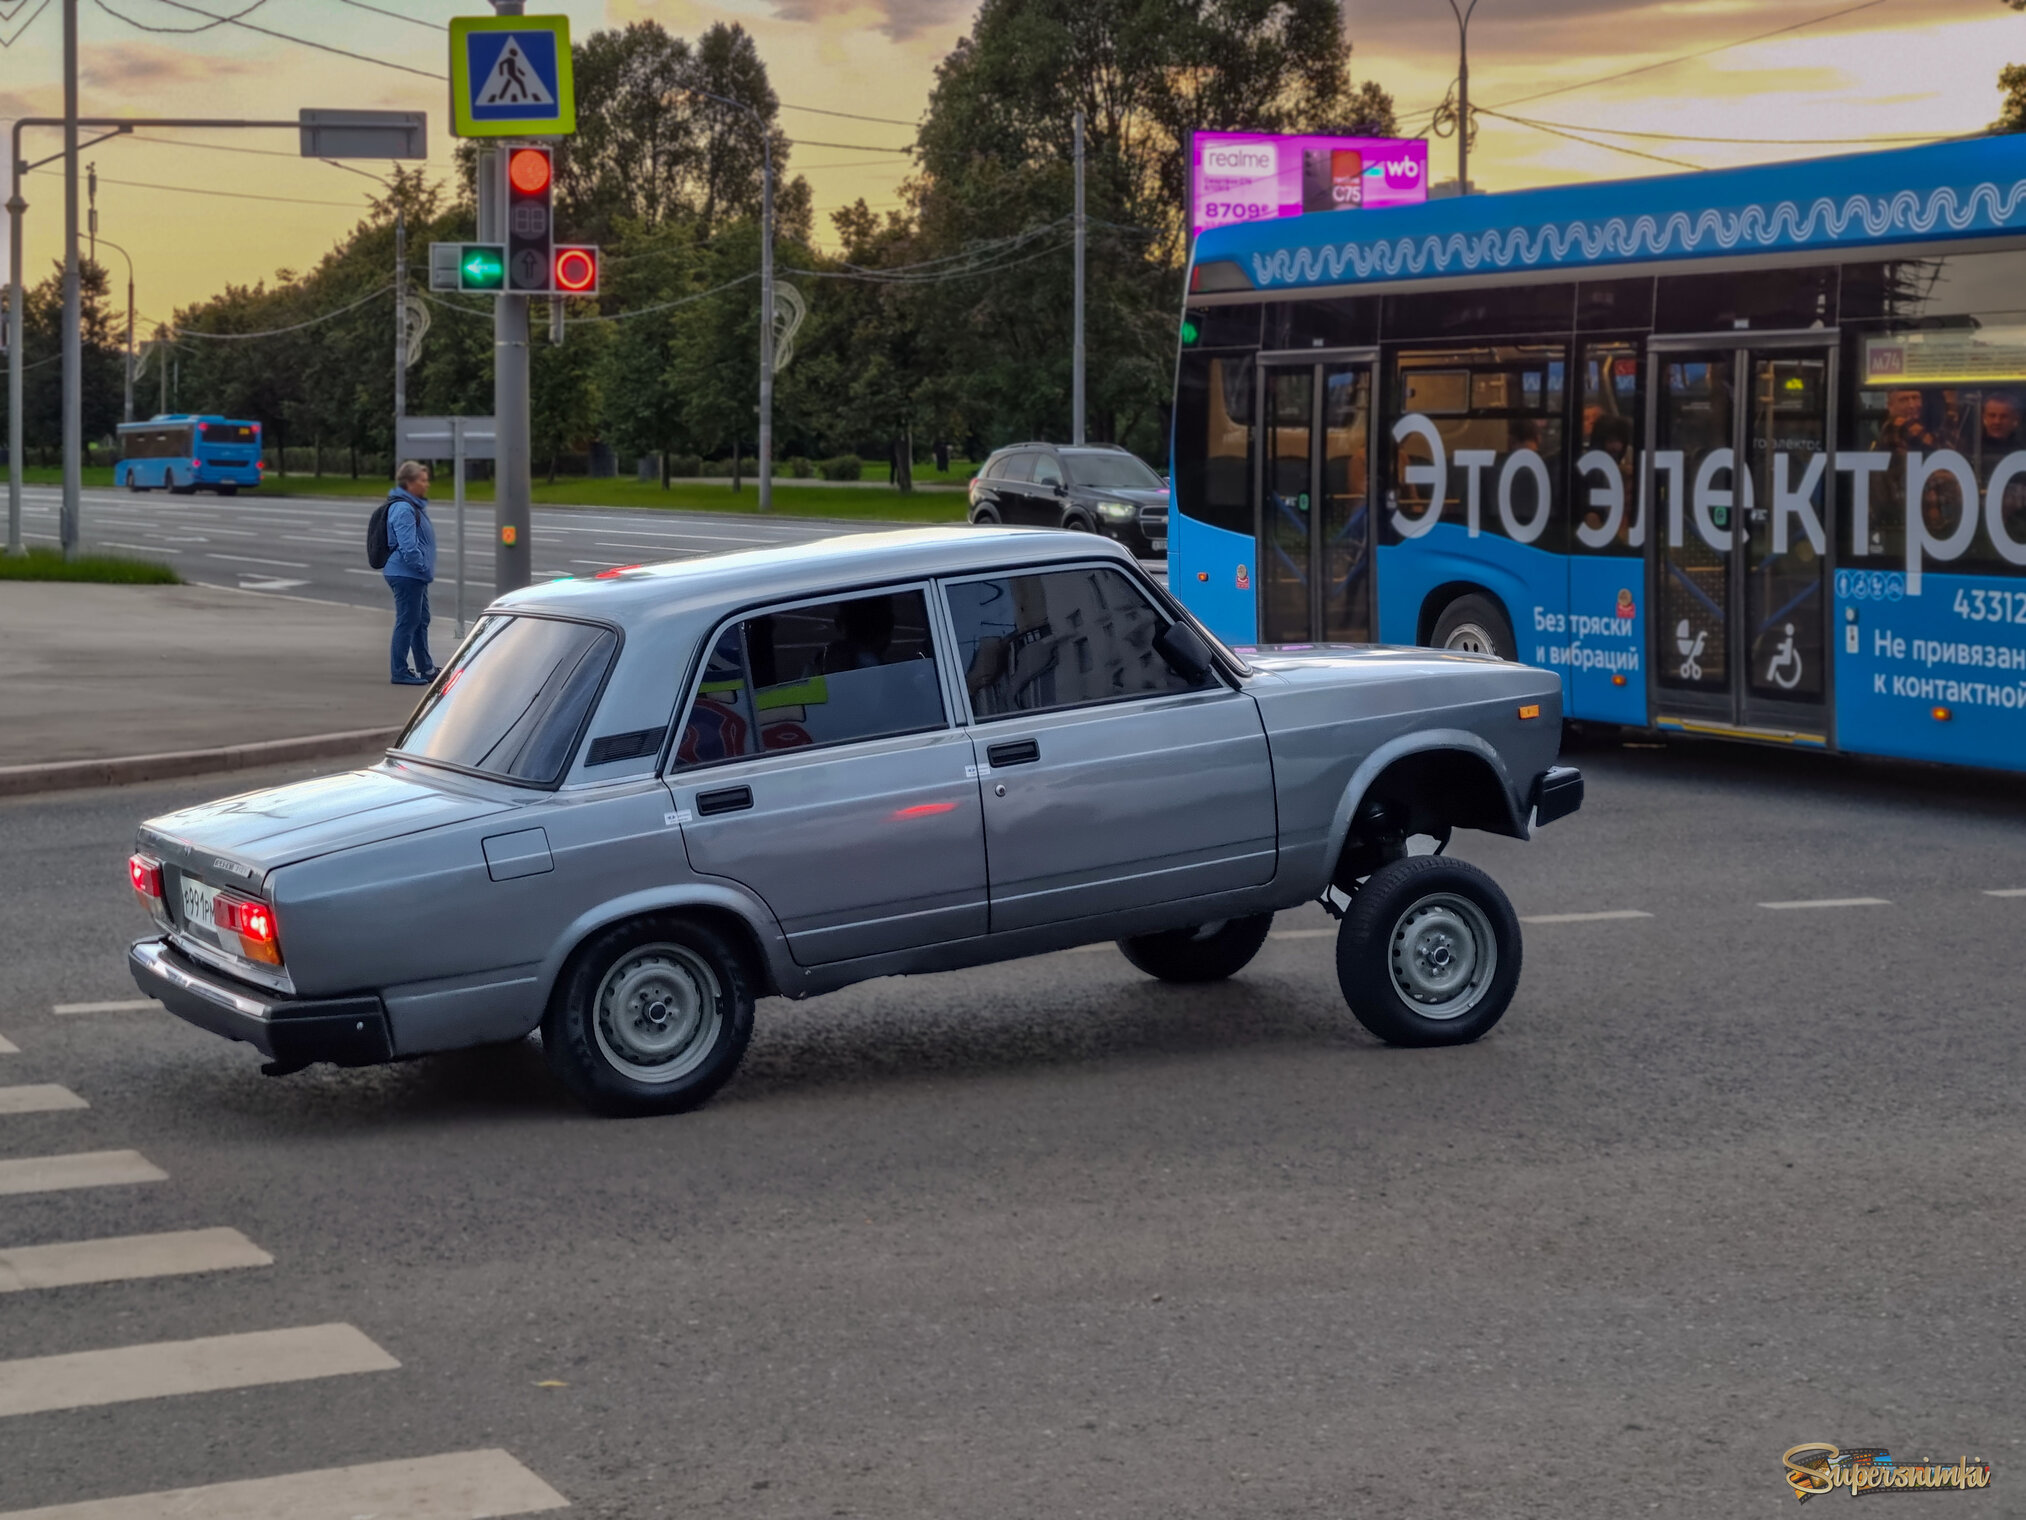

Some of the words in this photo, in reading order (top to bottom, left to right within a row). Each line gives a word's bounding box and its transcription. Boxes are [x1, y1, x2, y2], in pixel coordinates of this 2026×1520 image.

[1208, 150, 1270, 169] realme
[1387, 154, 1419, 178] wb
[1332, 185, 1361, 202] C75
[1391, 412, 1552, 543] Это
[1533, 605, 1565, 633] Без
[1569, 614, 1633, 639] тряски
[1535, 644, 1546, 664] и
[1550, 641, 1639, 673] вибраций
[1874, 629, 1907, 659] Не
[1912, 638, 2026, 670] привязан
[1873, 673, 1887, 694] к
